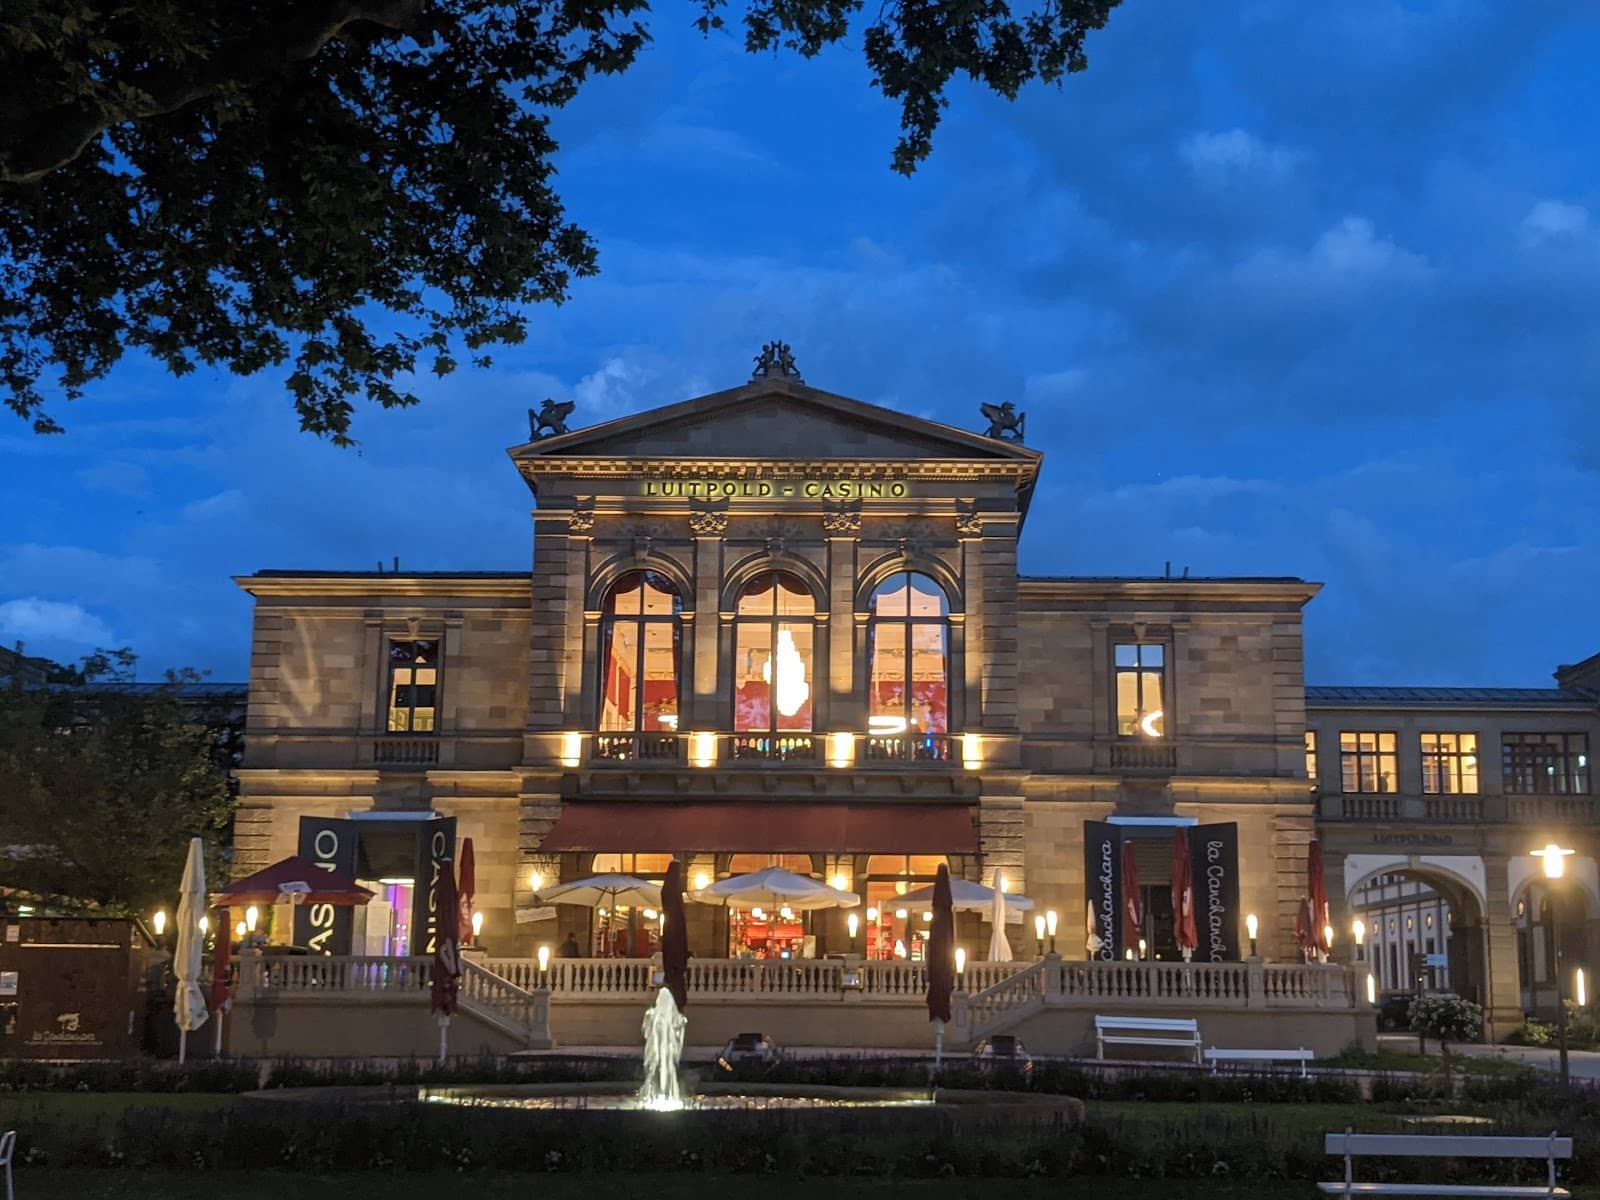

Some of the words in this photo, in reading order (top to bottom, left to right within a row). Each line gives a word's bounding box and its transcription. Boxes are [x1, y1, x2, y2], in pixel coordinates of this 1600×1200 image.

[647, 482, 771, 496] LUITPOLD
[805, 482, 905, 497] CASINO
[1207, 840, 1224, 863] la
